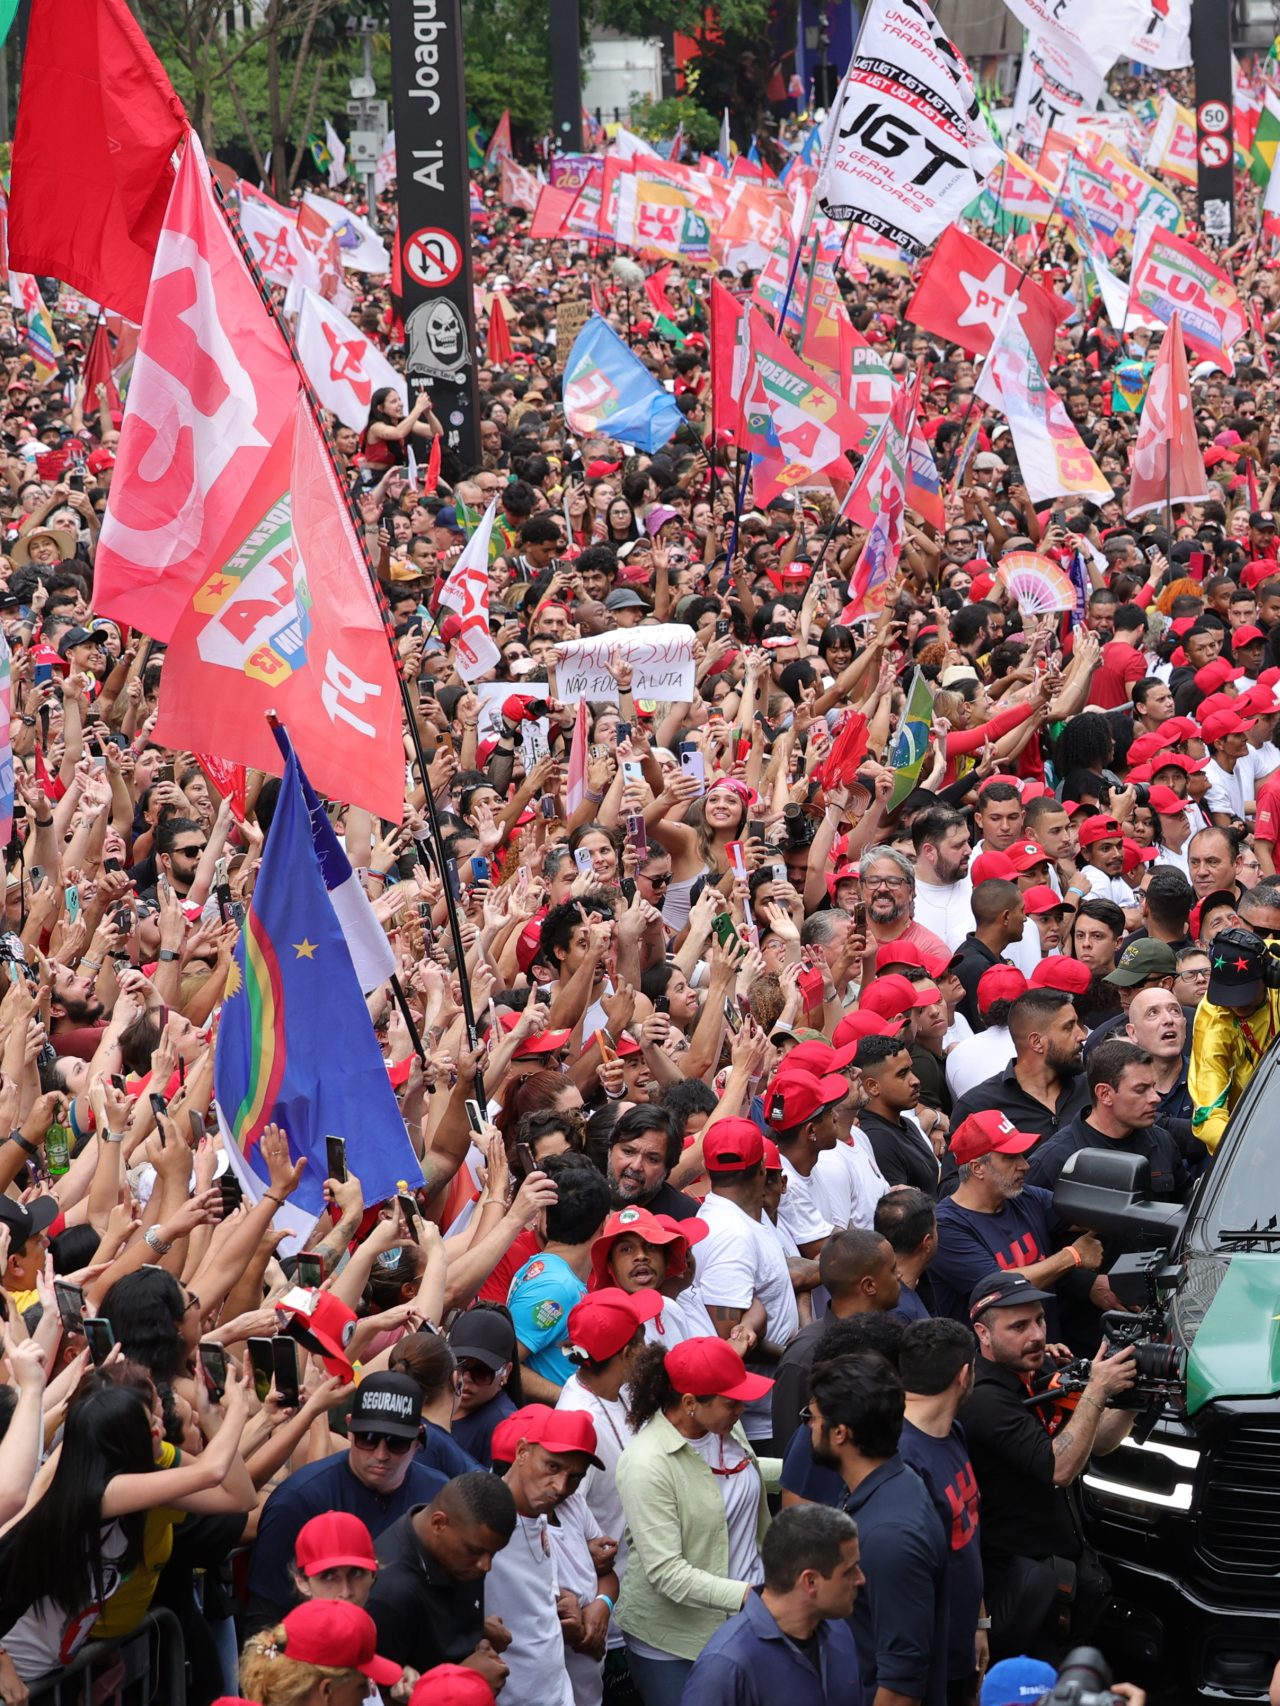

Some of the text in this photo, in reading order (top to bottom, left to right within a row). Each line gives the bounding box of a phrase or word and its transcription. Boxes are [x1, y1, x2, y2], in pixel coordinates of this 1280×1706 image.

[885, 9, 932, 41] UNIÃO
[866, 74, 891, 90] UGT
[890, 85, 917, 105] UGT
[917, 99, 944, 124] UGT
[874, 61, 899, 78] UGT
[900, 73, 926, 94] UGT
[926, 91, 952, 116] UGT
[1204, 109, 1226, 124] 50
[411, 139, 445, 192] Al.
[848, 150, 937, 209] GERAL DOS
[861, 212, 920, 251] UGT UGT
[976, 288, 1006, 319] PT
[1056, 442, 1095, 483] 13
[565, 671, 588, 696] NÃO
[650, 672, 683, 689] LUTA
[362, 1390, 414, 1419] SEGURANÇA
